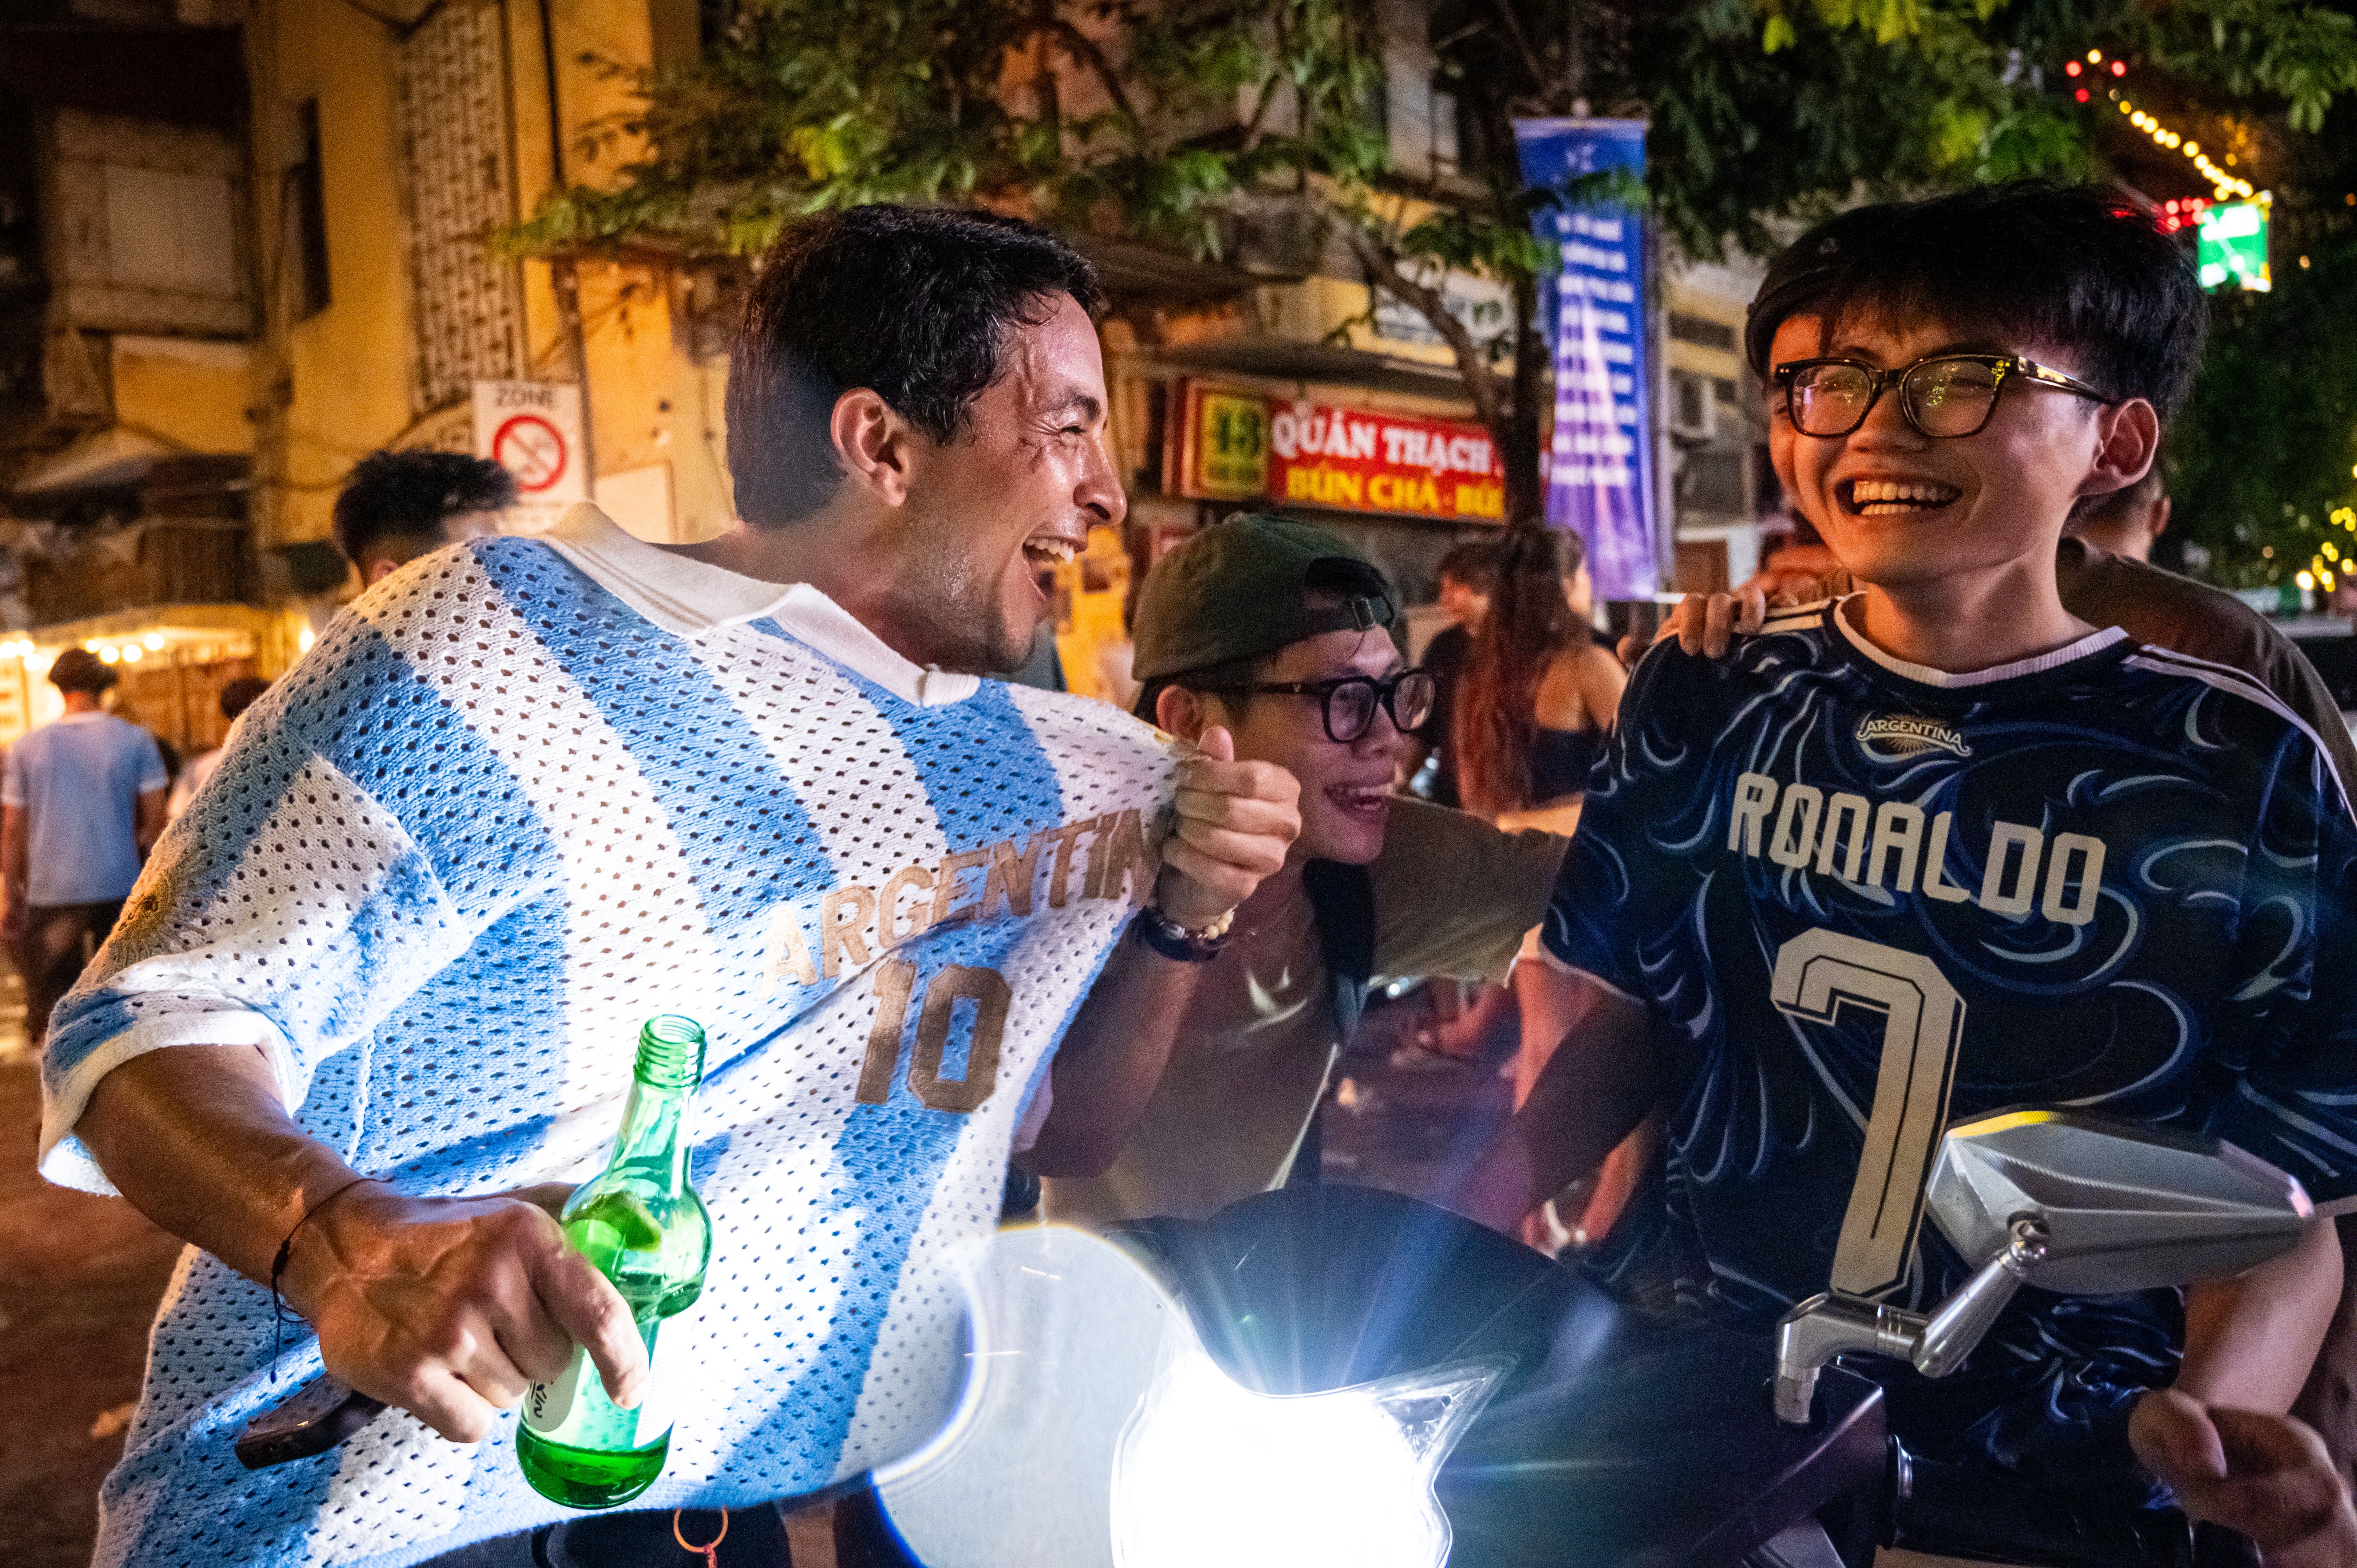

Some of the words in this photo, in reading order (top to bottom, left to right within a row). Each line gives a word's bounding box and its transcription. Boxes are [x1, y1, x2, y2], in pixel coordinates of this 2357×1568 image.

[1272, 411, 1375, 460] QUÁN
[1382, 425, 1489, 476] THẠCH
[1287, 461, 1361, 502] BÚN
[1456, 480, 1504, 518] BÚ
[1864, 719, 1970, 753] ARGENTINA
[757, 808, 1158, 999] ARGENTIN
[1728, 771, 2107, 926] RONALDO
[855, 957, 1013, 1113] 10
[1770, 927, 1966, 1301] 7
